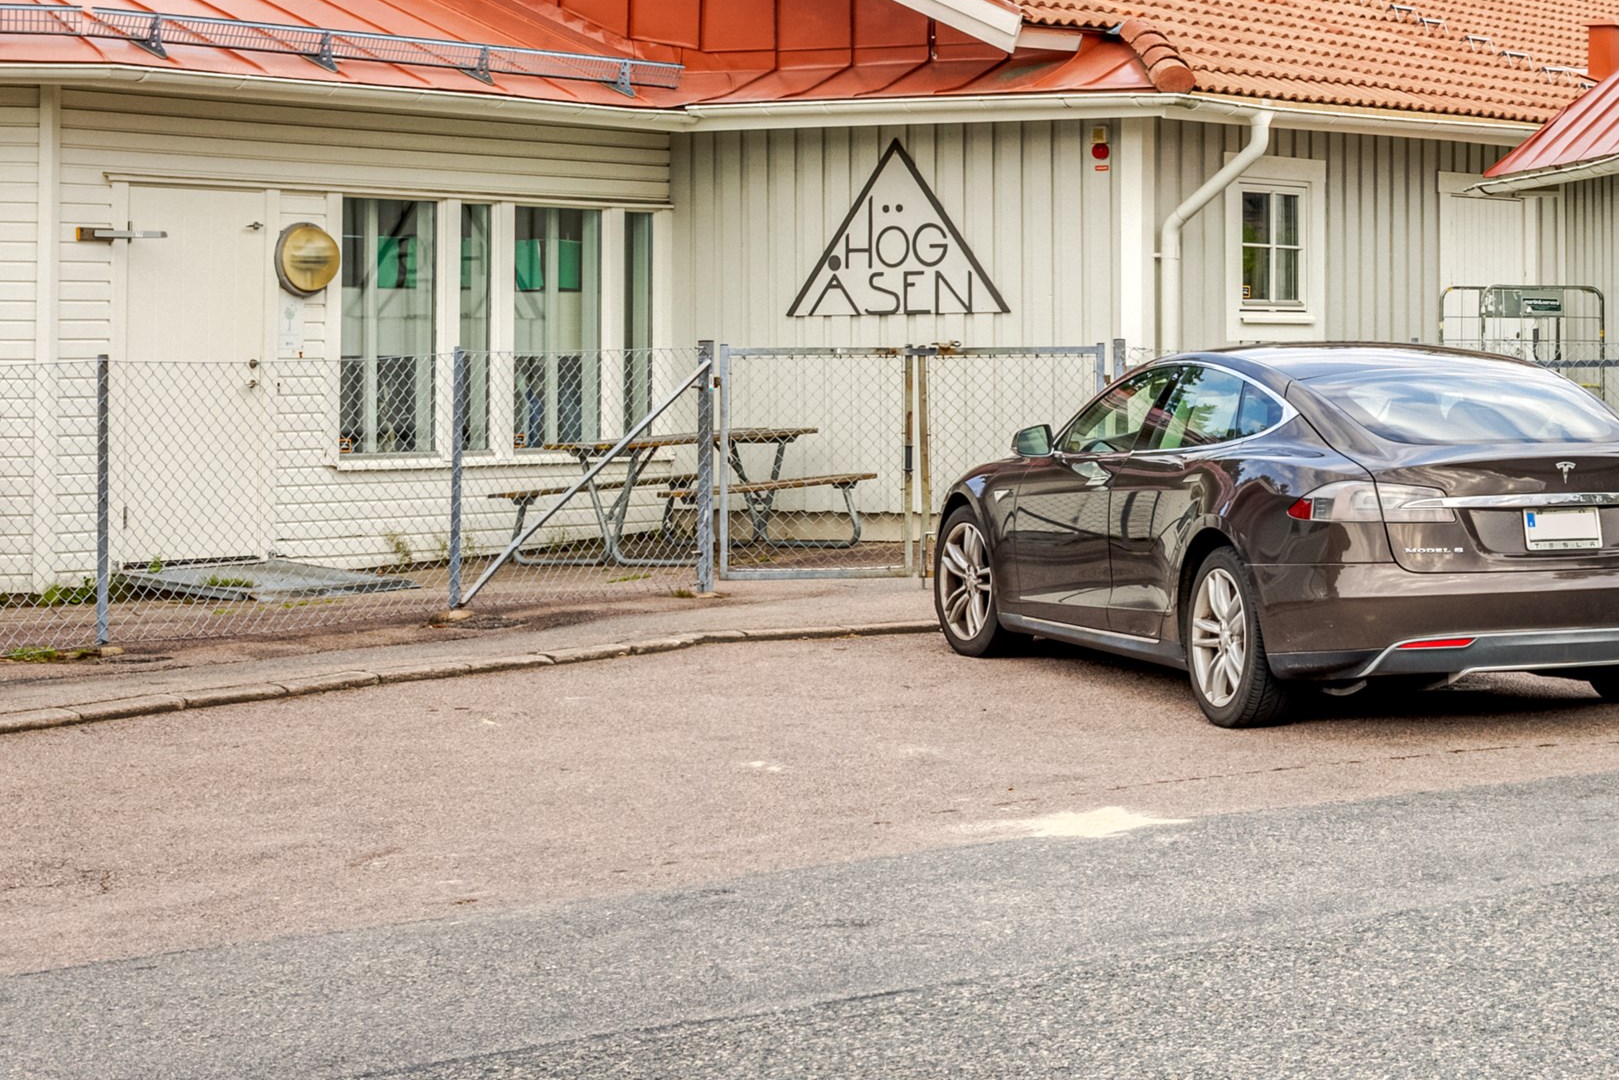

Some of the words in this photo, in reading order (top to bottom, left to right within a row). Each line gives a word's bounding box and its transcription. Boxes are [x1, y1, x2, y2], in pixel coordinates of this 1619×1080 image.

[845, 195, 948, 269] HÖG
[808, 254, 973, 316] ÅSEN
[1534, 541, 1596, 549] TESLA
